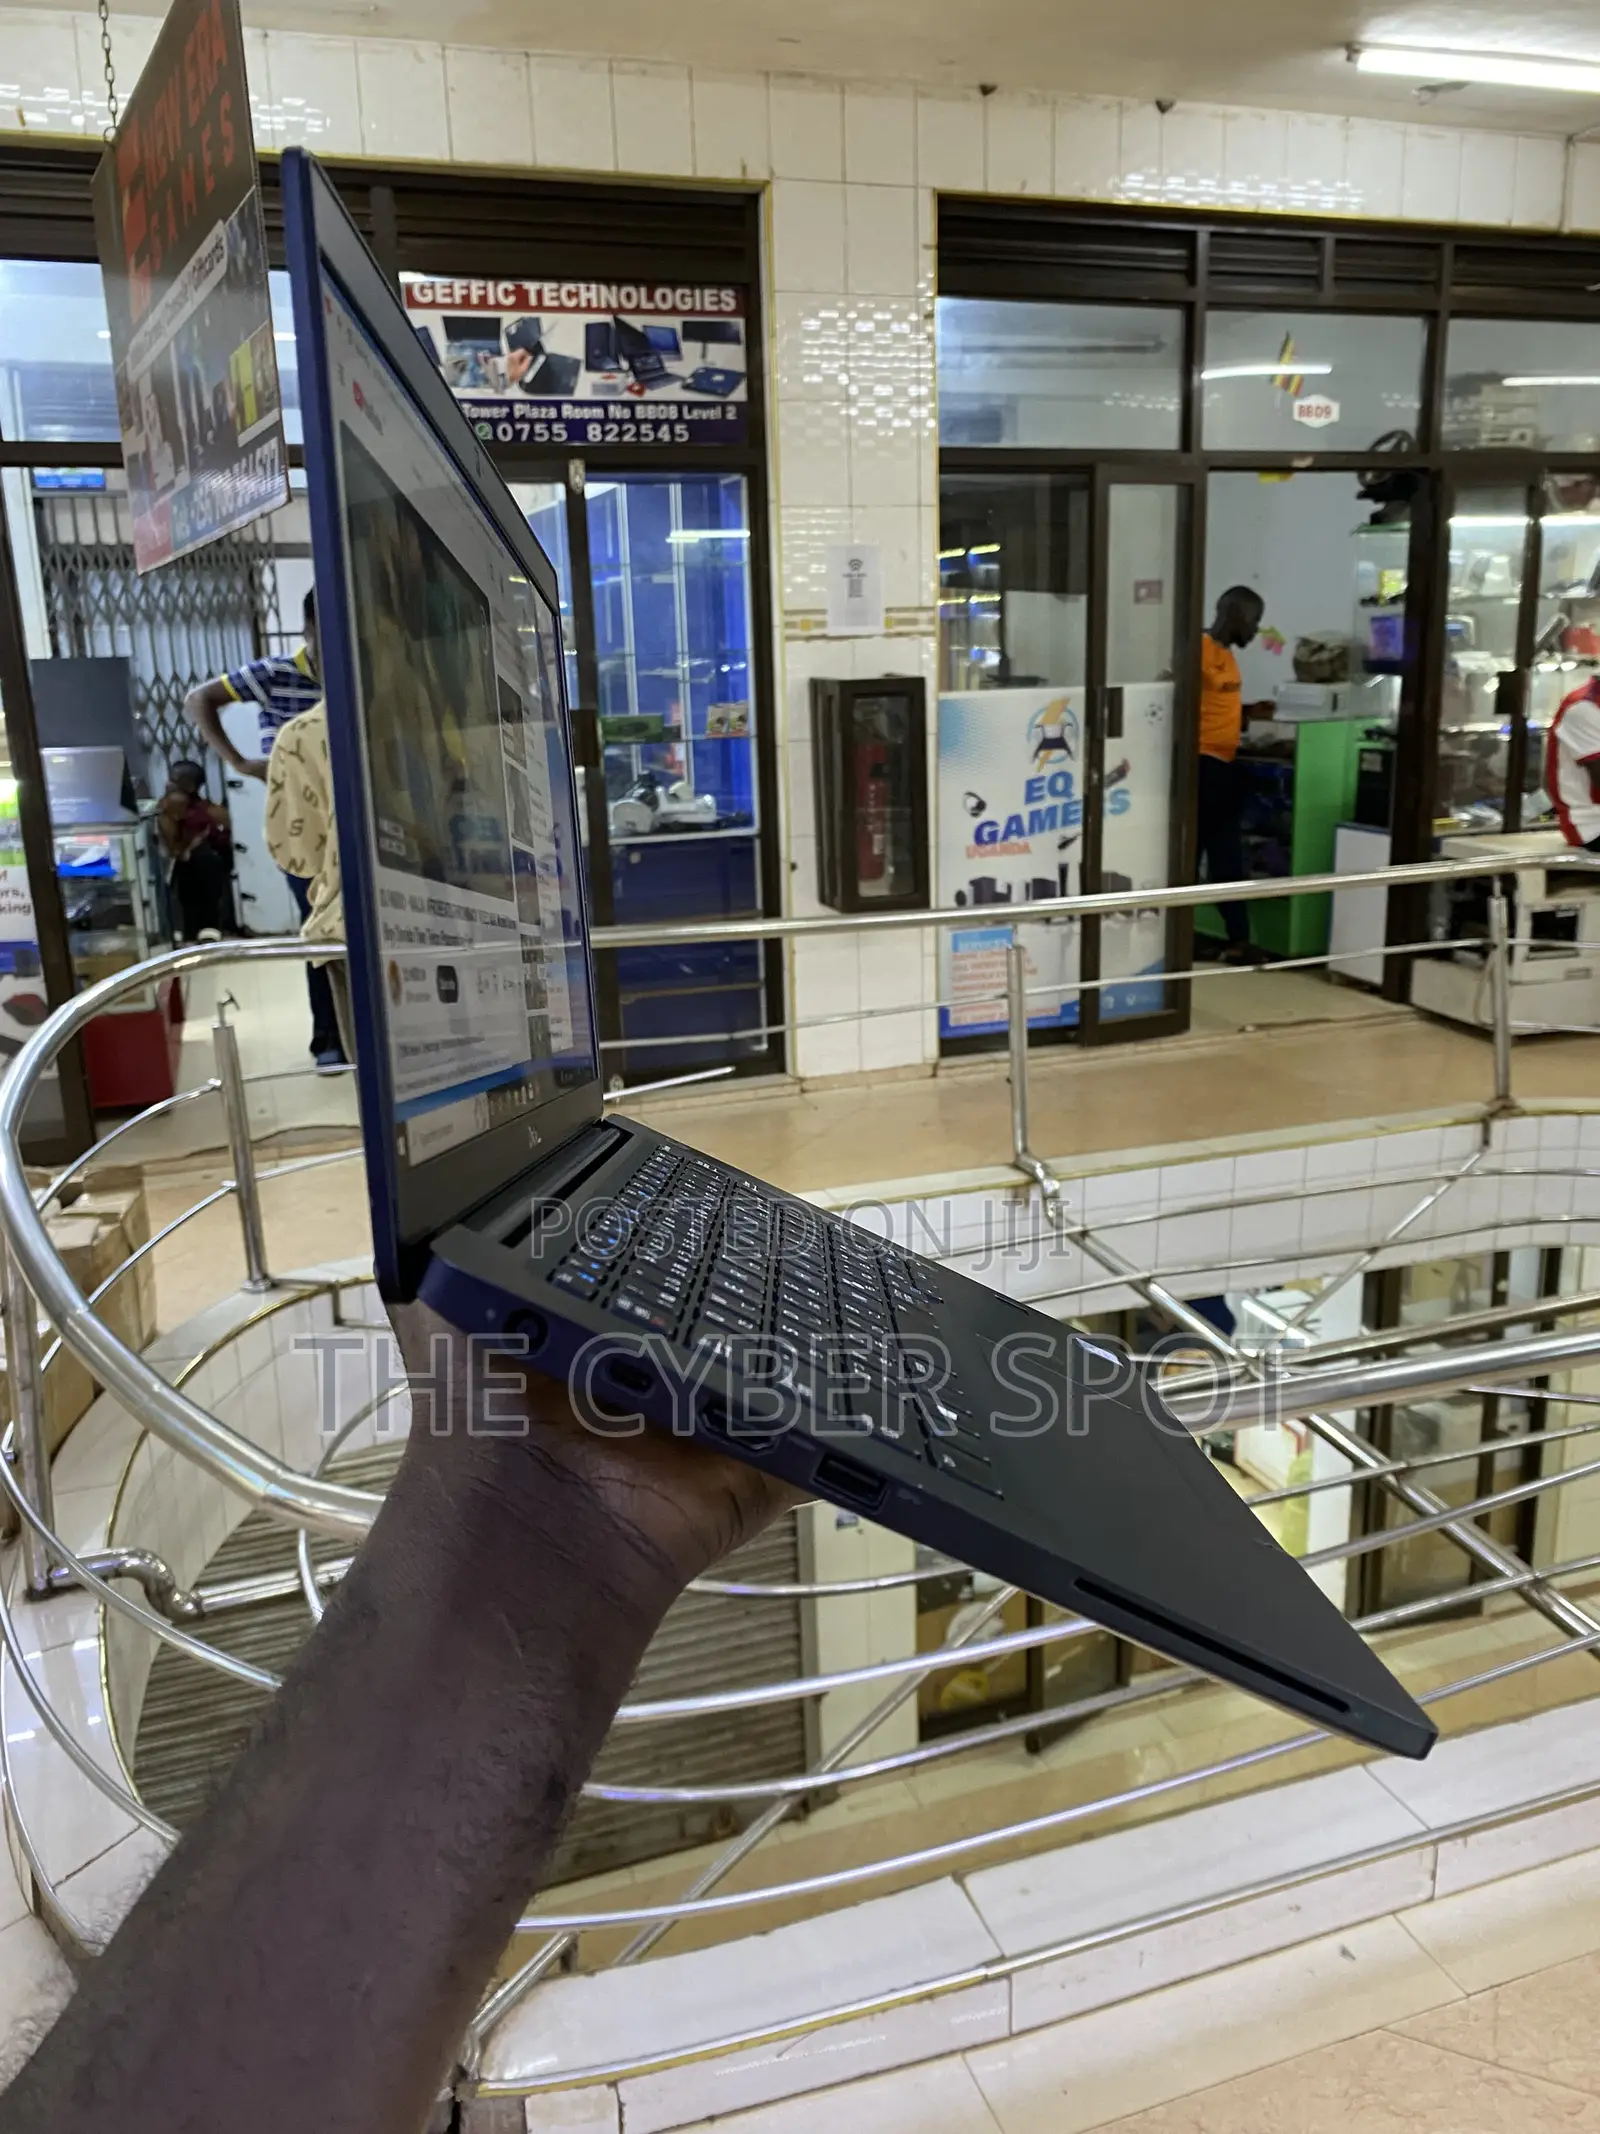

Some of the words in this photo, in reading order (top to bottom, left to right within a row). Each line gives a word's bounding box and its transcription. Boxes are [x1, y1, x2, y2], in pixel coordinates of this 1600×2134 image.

[412, 281, 517, 306] GEFFIC
[522, 283, 737, 312] TECHNOLOGIES
[462, 403, 510, 419] Tower
[513, 403, 558, 420] Plaza
[561, 404, 604, 420] Room
[608, 404, 632, 420] No
[682, 404, 722, 420] Level
[726, 405, 738, 420] 2
[497, 421, 568, 443] 0755
[587, 422, 690, 443] 822545
[1024, 770, 1075, 805] EQ
[974, 788, 1132, 847] GAMES
